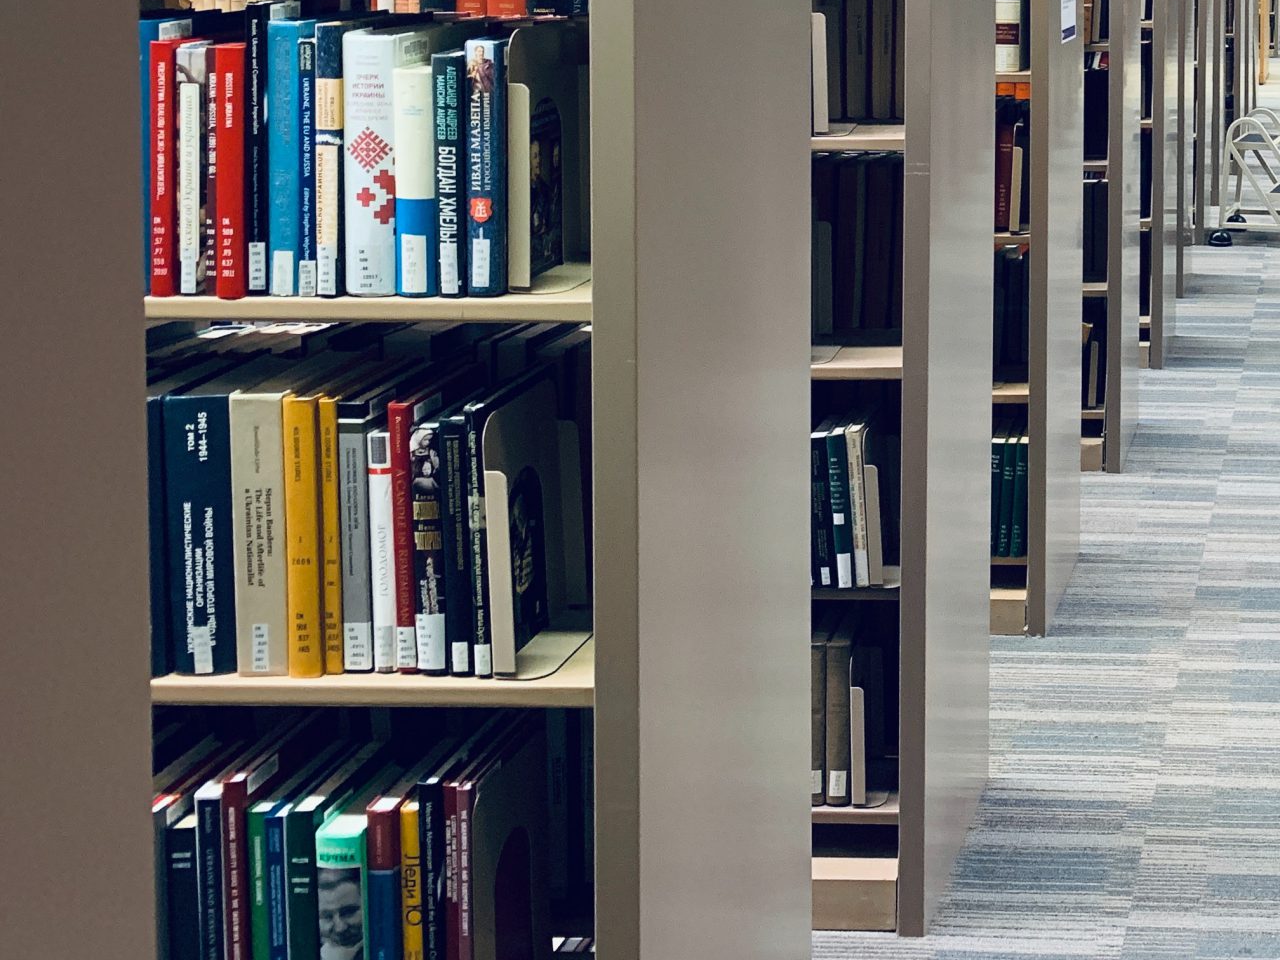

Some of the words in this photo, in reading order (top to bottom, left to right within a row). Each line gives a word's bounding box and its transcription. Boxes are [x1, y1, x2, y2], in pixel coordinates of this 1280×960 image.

[302, 77, 310, 110] UKRAINE,
[436, 75, 446, 107] МАКСИМ
[446, 65, 457, 107] АЛЕКСАНДР
[303, 110, 311, 124] THE
[303, 125, 311, 135] EU
[436, 108, 446, 140] АНДРЕЕВ
[447, 108, 458, 140] АНДРЕЕВ
[470, 92, 481, 149] МАЗЕПА
[303, 136, 311, 152] AND
[483, 131, 492, 184] РОССИЙСКАЯ
[303, 152, 311, 177] RUSSIA
[437, 146, 456, 193] БОГДАН
[470, 152, 481, 192] ИВАН
[187, 432, 195, 451] ТОМ
[255, 488, 263, 504] The
[264, 488, 273, 517] Stepan
[204, 507, 214, 538] ВОЙНЫ
[244, 495, 253, 538] Ukrainian
[255, 506, 263, 523] Life
[256, 523, 264, 540] and
[266, 519, 274, 557] Bandera:
[183, 501, 193, 603] НАЦИОНАЛИСТИЧЕСКИЕ
[204, 539, 215, 580] МИРОВОЙ
[246, 540, 255, 586] Nationalist
[256, 542, 265, 576] Afterlife
[195, 547, 204, 608] ОРГАНИЗАЦИИ
[257, 577, 265, 587] of
[205, 581, 216, 613] ВТОРОЙ
[404, 853, 417, 900] Леди
[405, 906, 422, 926] Ю
